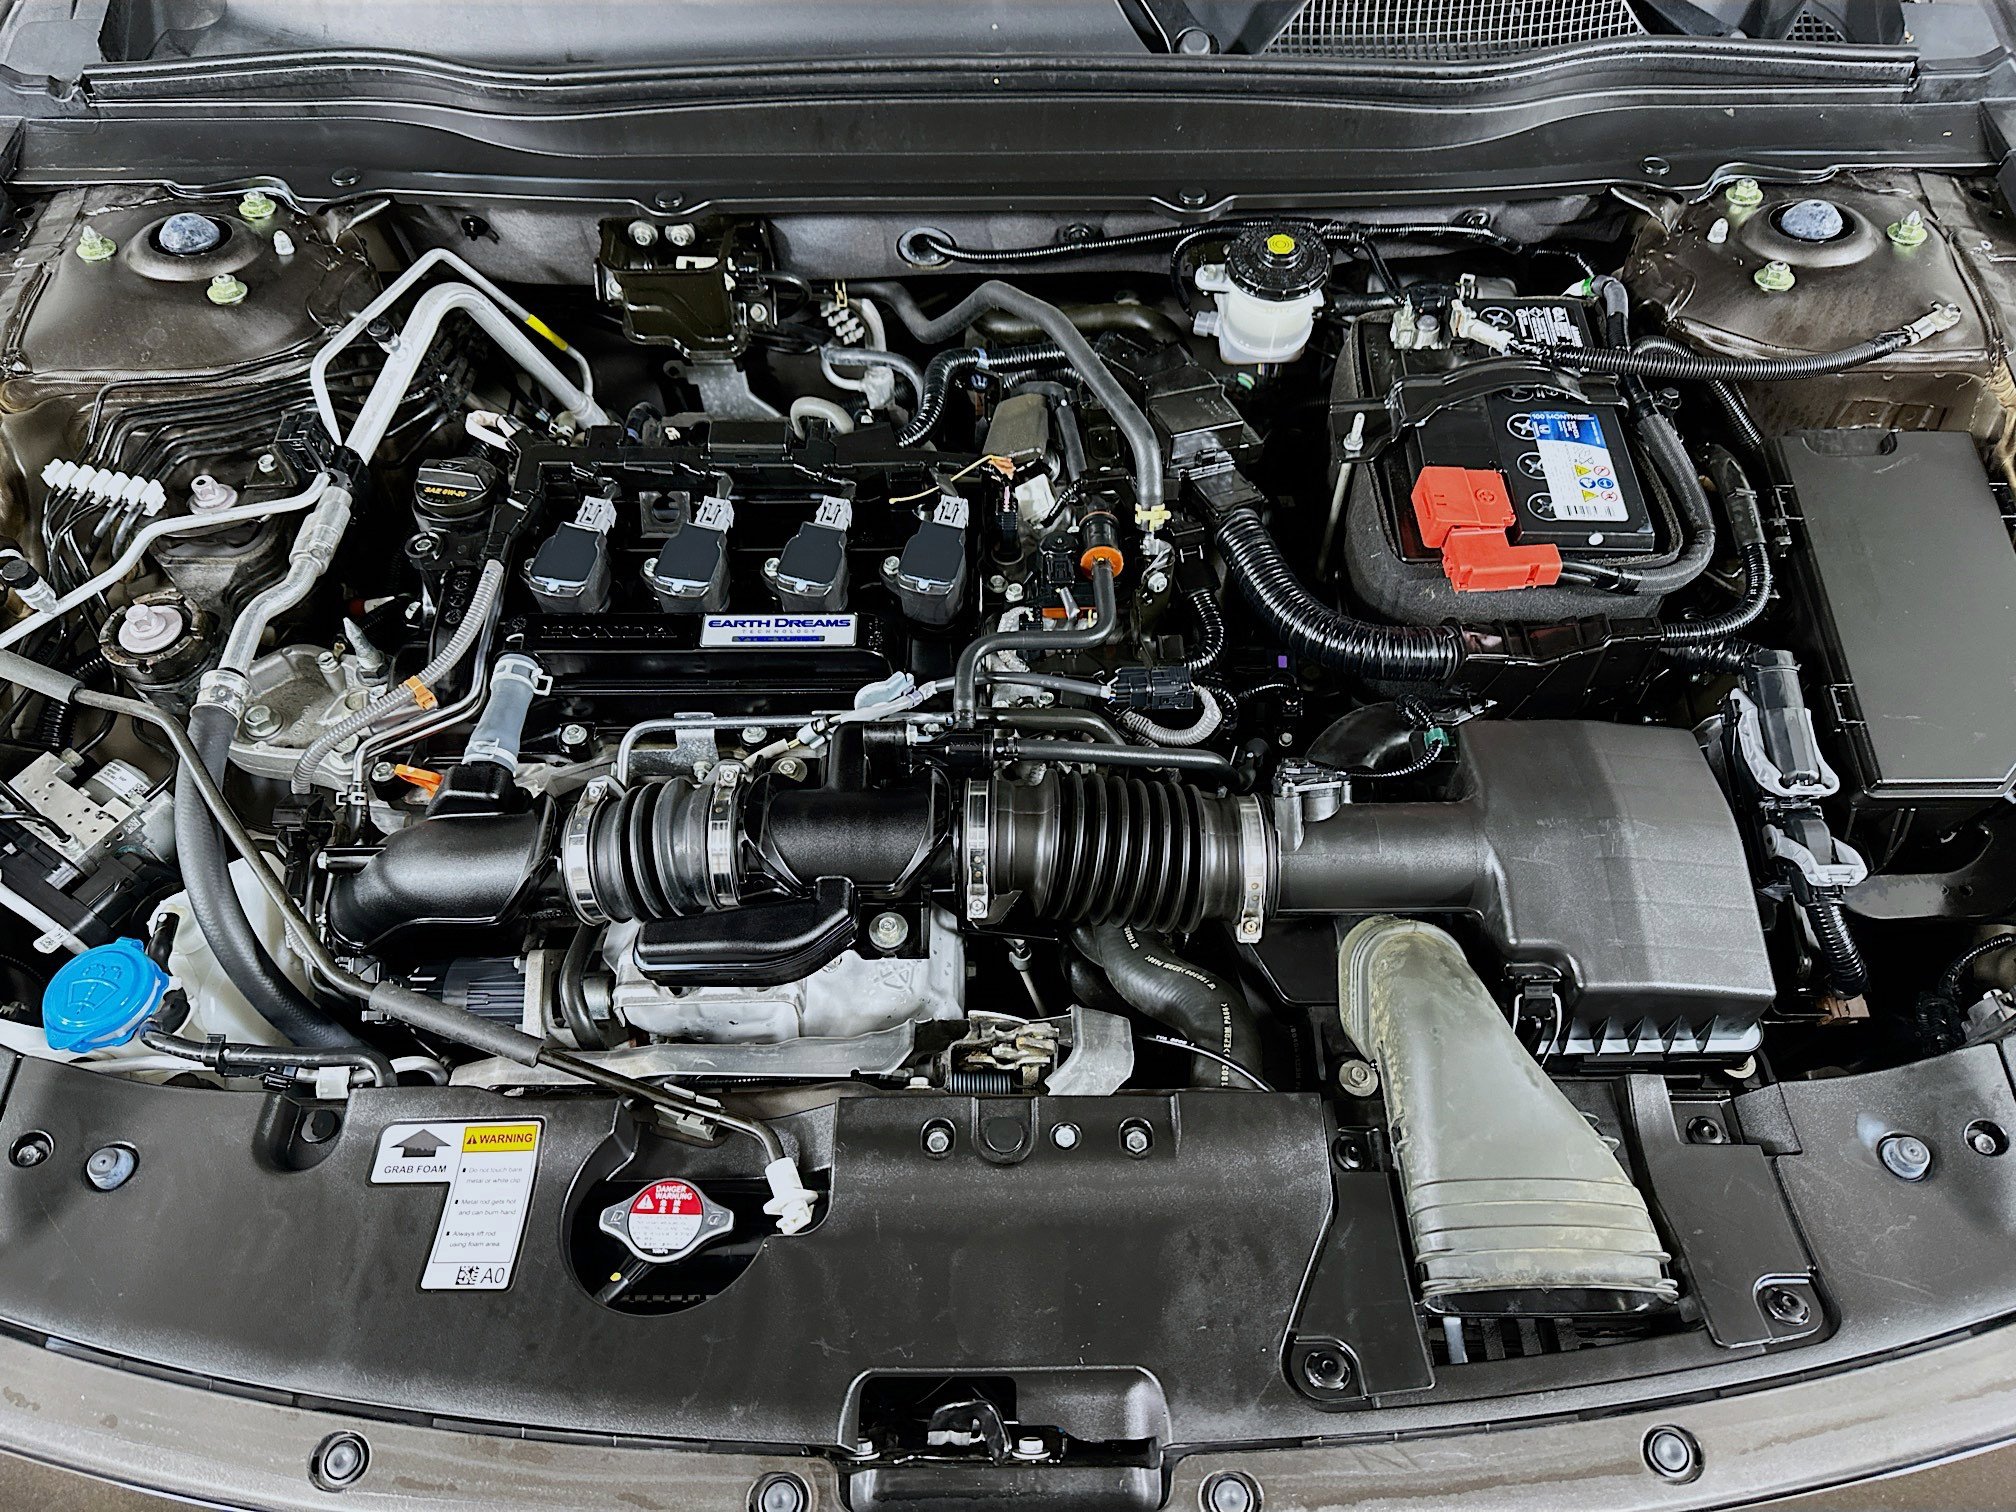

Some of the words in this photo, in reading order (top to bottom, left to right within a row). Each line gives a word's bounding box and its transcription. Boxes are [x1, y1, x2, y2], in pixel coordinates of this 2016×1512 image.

[424, 486, 442, 494] SAE
[708, 619, 771, 628] EARTH
[774, 618, 850, 628] DREAMS
[541, 625, 677, 638] HONDA
[479, 1133, 533, 1144] WARNING
[384, 1165, 414, 1174] GRAB
[416, 1165, 447, 1173] FOAM
[655, 1185, 687, 1193] DANGER
[480, 1267, 505, 1284] A0
